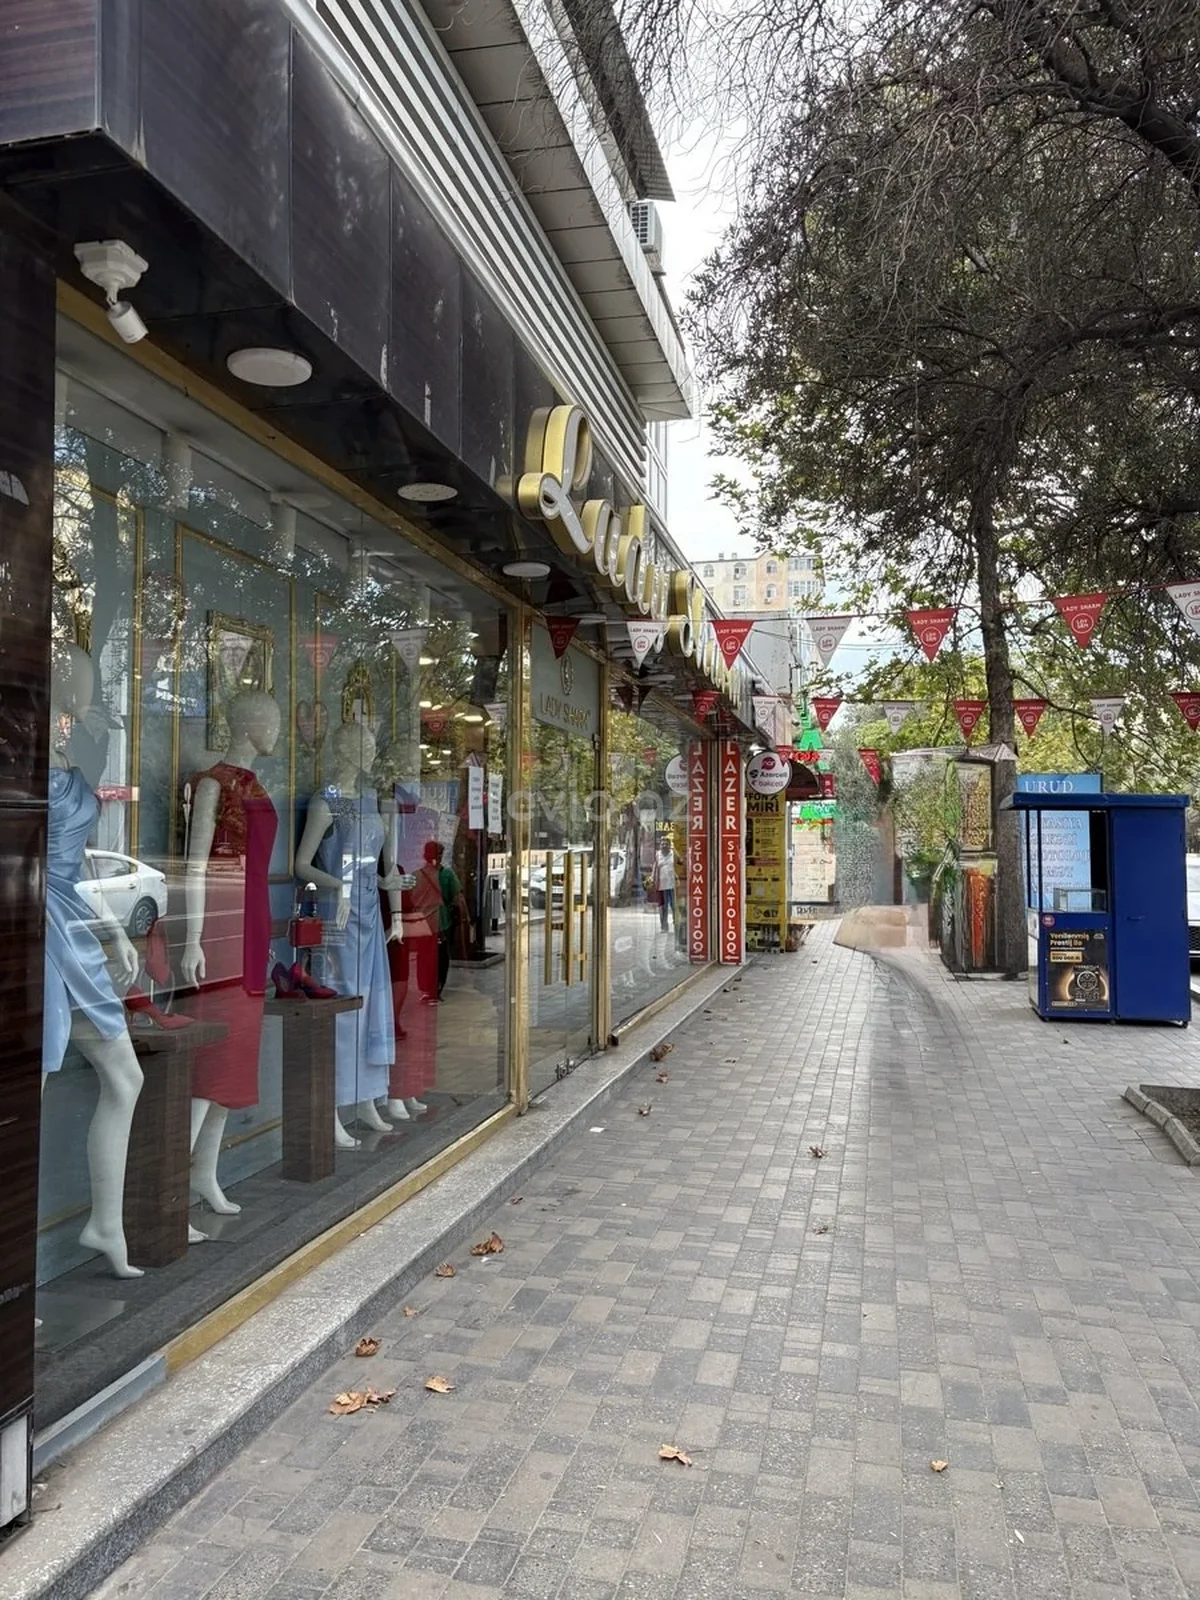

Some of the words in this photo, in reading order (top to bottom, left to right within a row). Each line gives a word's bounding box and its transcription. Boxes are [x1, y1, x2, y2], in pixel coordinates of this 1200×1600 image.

[1174, 591, 1191, 599] LADY
[724, 740, 737, 830] LAZER
[1025, 780, 1074, 793] URUD
[725, 841, 737, 954] STOMATOLOQ
